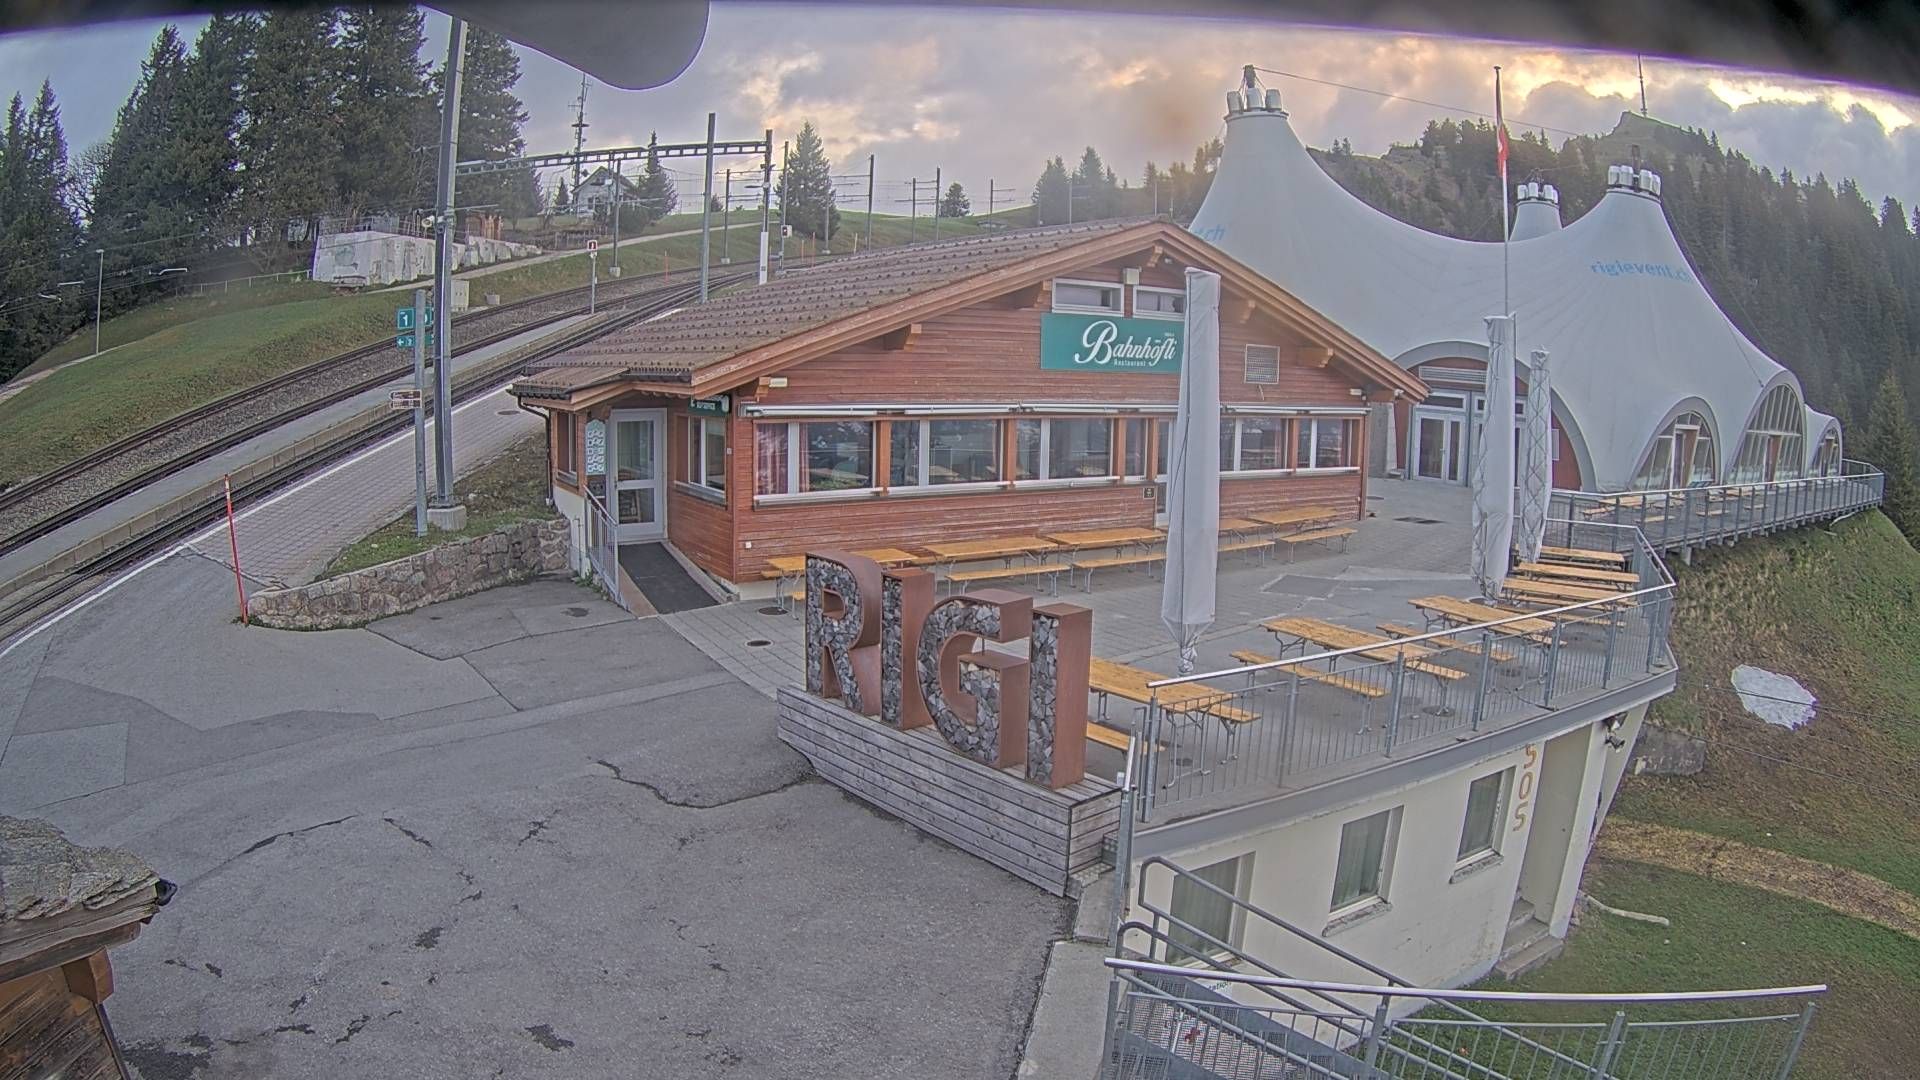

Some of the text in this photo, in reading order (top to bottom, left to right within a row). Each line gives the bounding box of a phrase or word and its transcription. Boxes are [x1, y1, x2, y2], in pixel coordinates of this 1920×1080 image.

[402, 314, 409, 327] 1
[1074, 320, 1177, 367] Bahnhöfli
[1113, 359, 1147, 367] Restaurant
[805, 548, 1093, 790] RIGI
[1512, 743, 1538, 832] SOS
